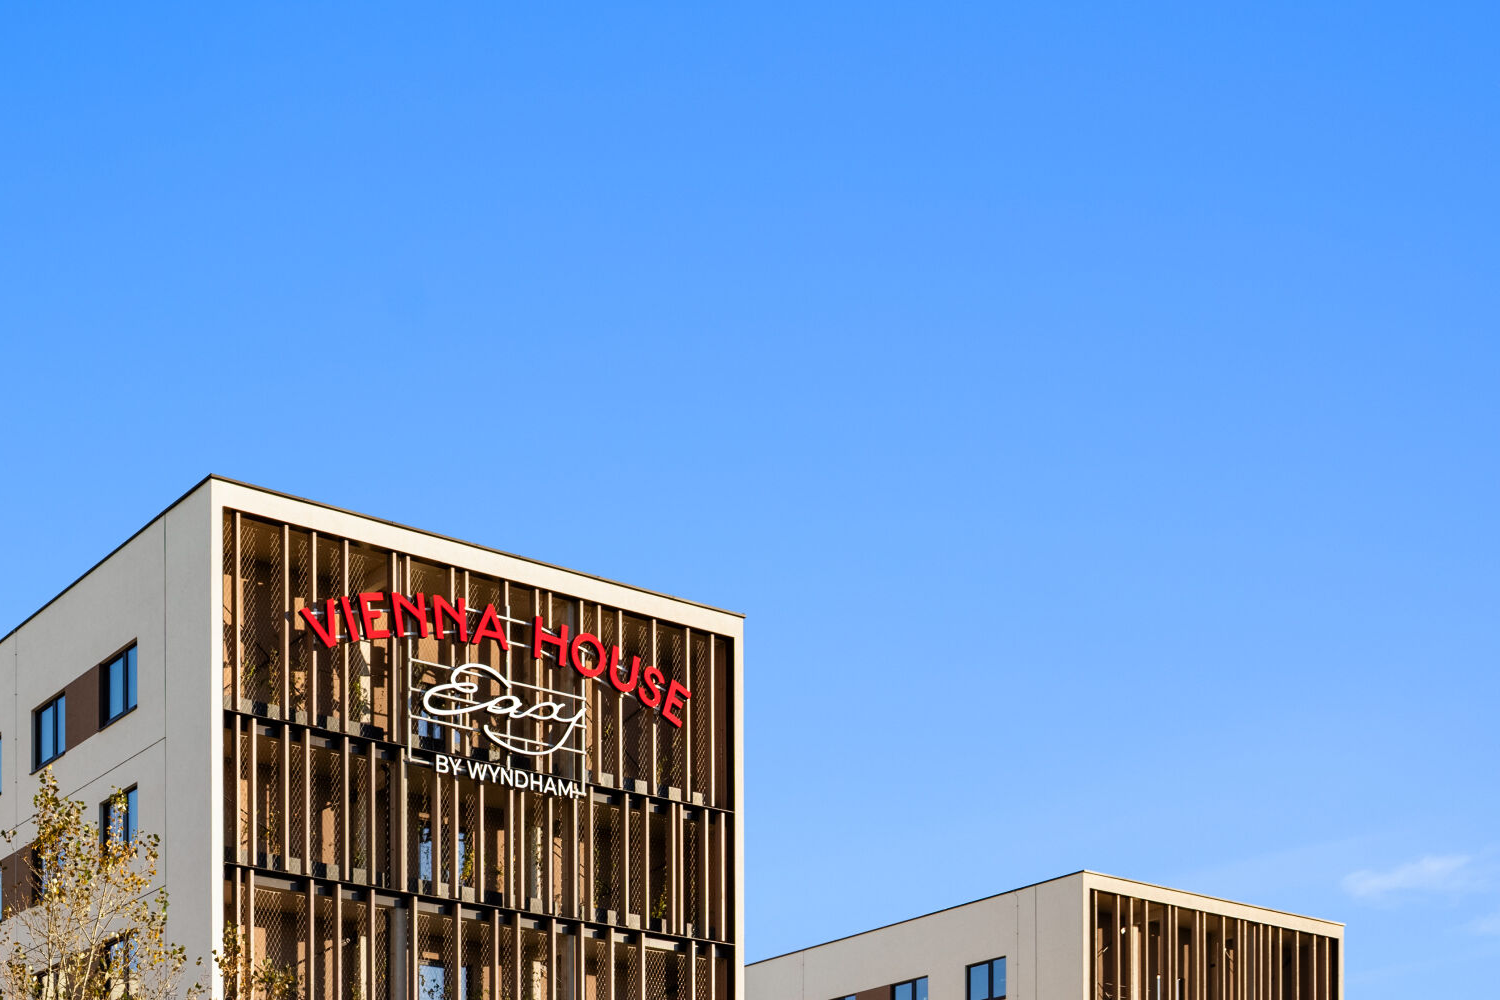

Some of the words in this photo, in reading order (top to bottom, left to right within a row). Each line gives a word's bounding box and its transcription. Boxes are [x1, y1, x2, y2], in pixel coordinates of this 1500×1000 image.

[301, 592, 509, 651] VIENNA
[533, 616, 691, 728] HOUSE
[423, 663, 586, 755] Easy
[436, 755, 463, 776] BY
[466, 760, 573, 797] WYNDHAM
